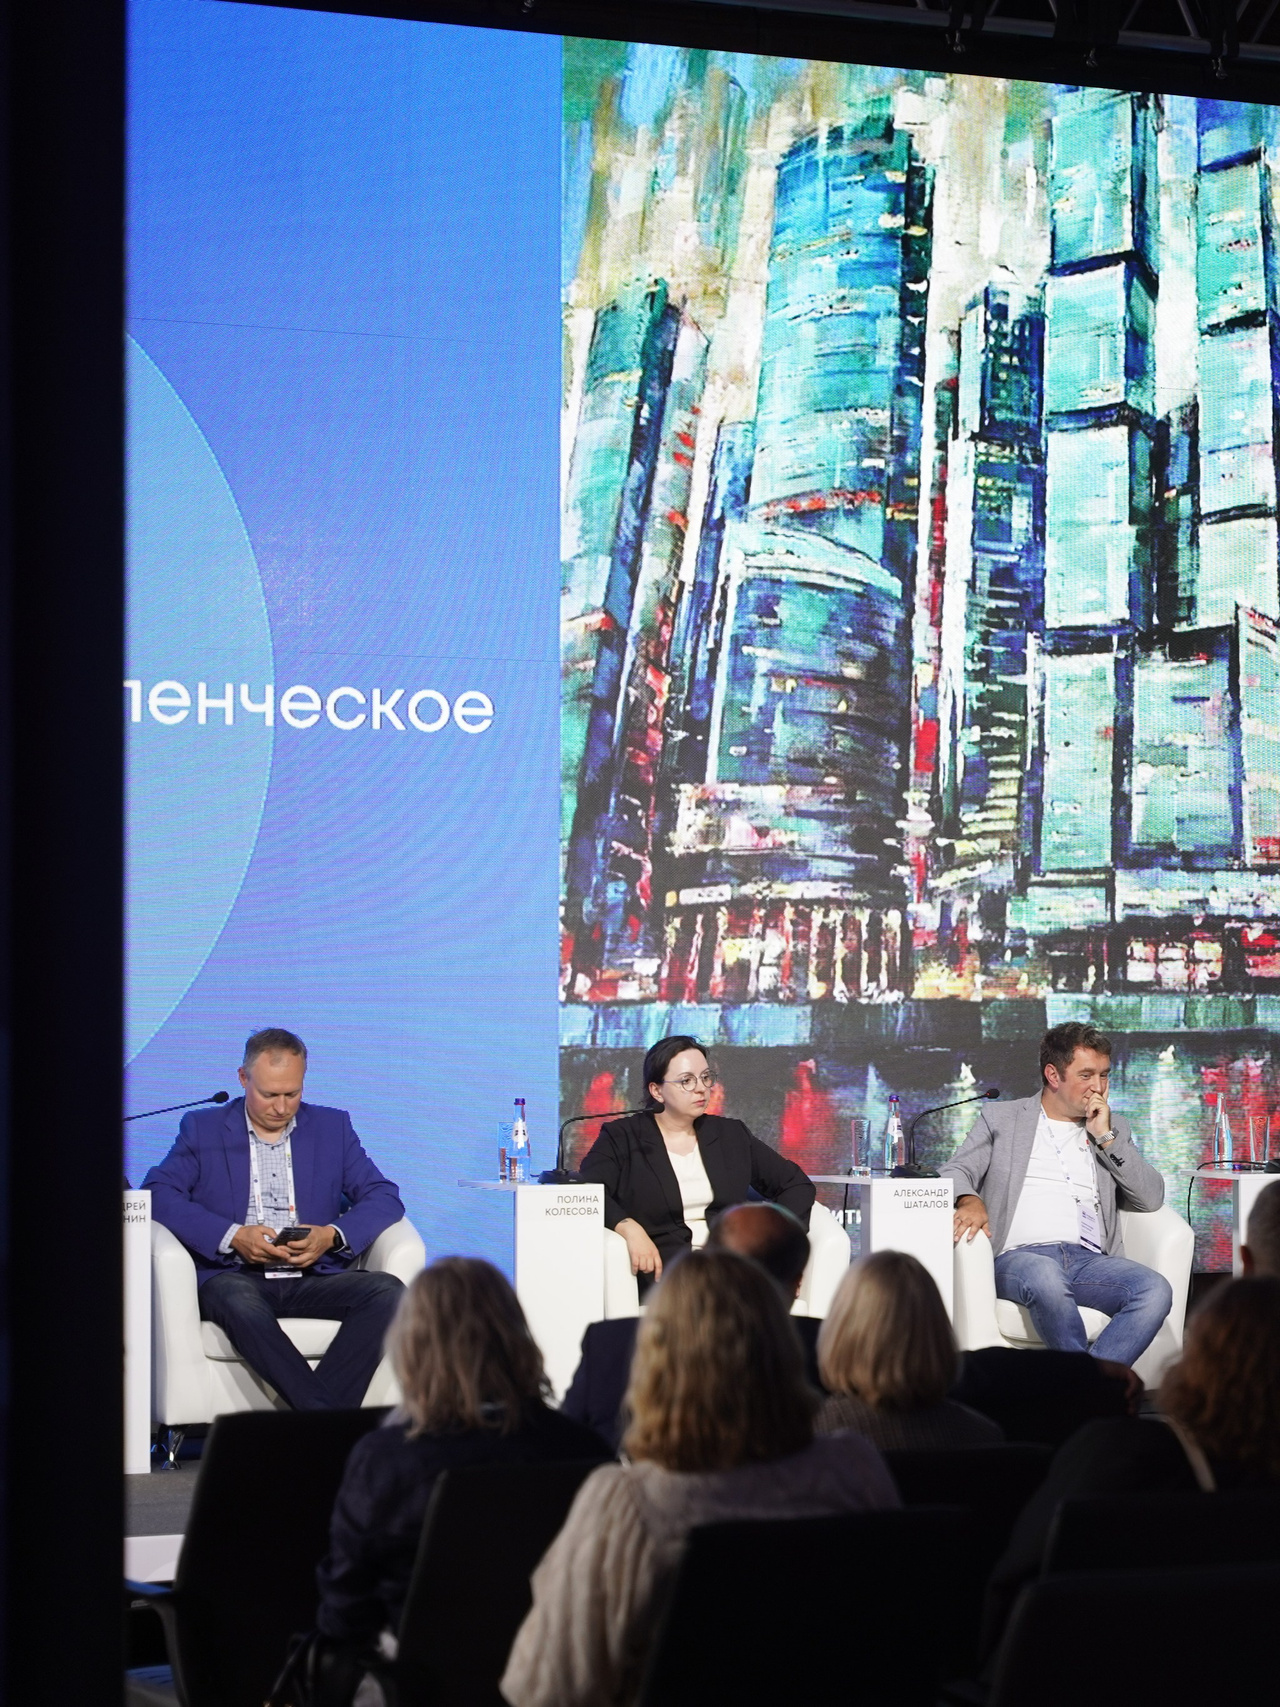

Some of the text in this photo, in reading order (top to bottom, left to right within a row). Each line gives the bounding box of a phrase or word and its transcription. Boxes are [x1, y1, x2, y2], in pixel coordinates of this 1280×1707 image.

[893, 1189, 949, 1198] АЛЕКСАНДР
[557, 1195, 600, 1204] ПОЛИНА
[904, 1200, 949, 1209] ШАТАЛОВ
[545, 1207, 600, 1216] КОЛЕСОВА
